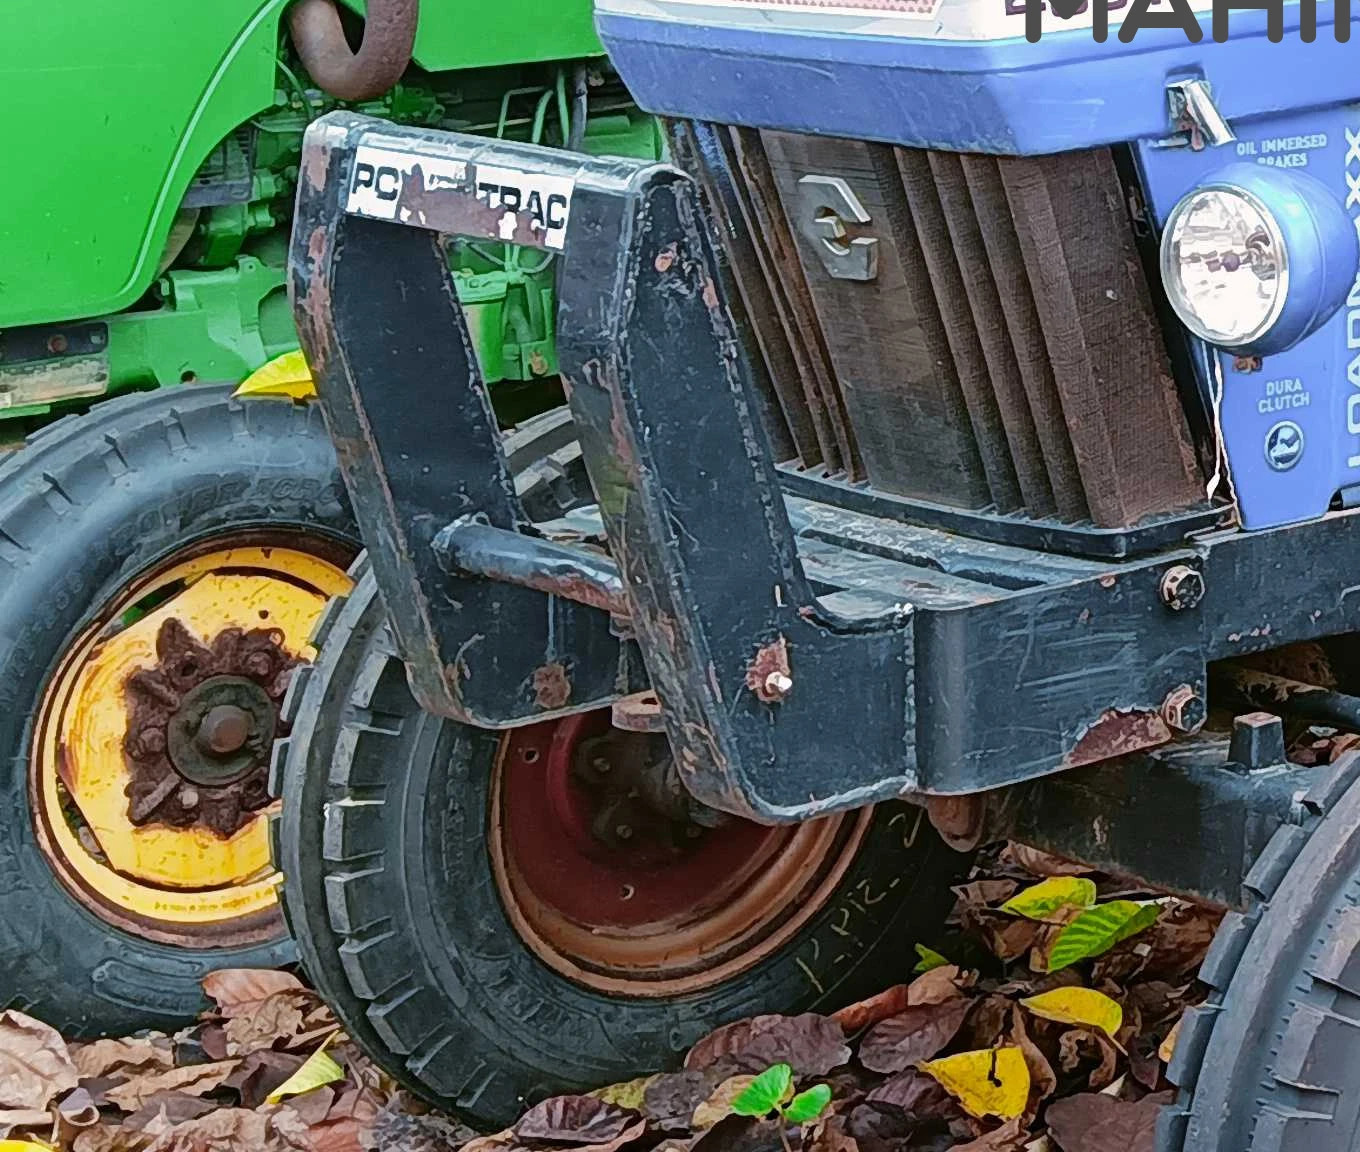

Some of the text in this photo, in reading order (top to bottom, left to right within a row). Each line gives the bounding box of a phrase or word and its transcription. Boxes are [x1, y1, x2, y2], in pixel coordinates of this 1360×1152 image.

[1236, 134, 1328, 156] OIL IMMERSED
[352, 162, 567, 231] POTRAC
[1266, 378, 1303, 395] DURA
[1257, 394, 1311, 414] CLUTCH
